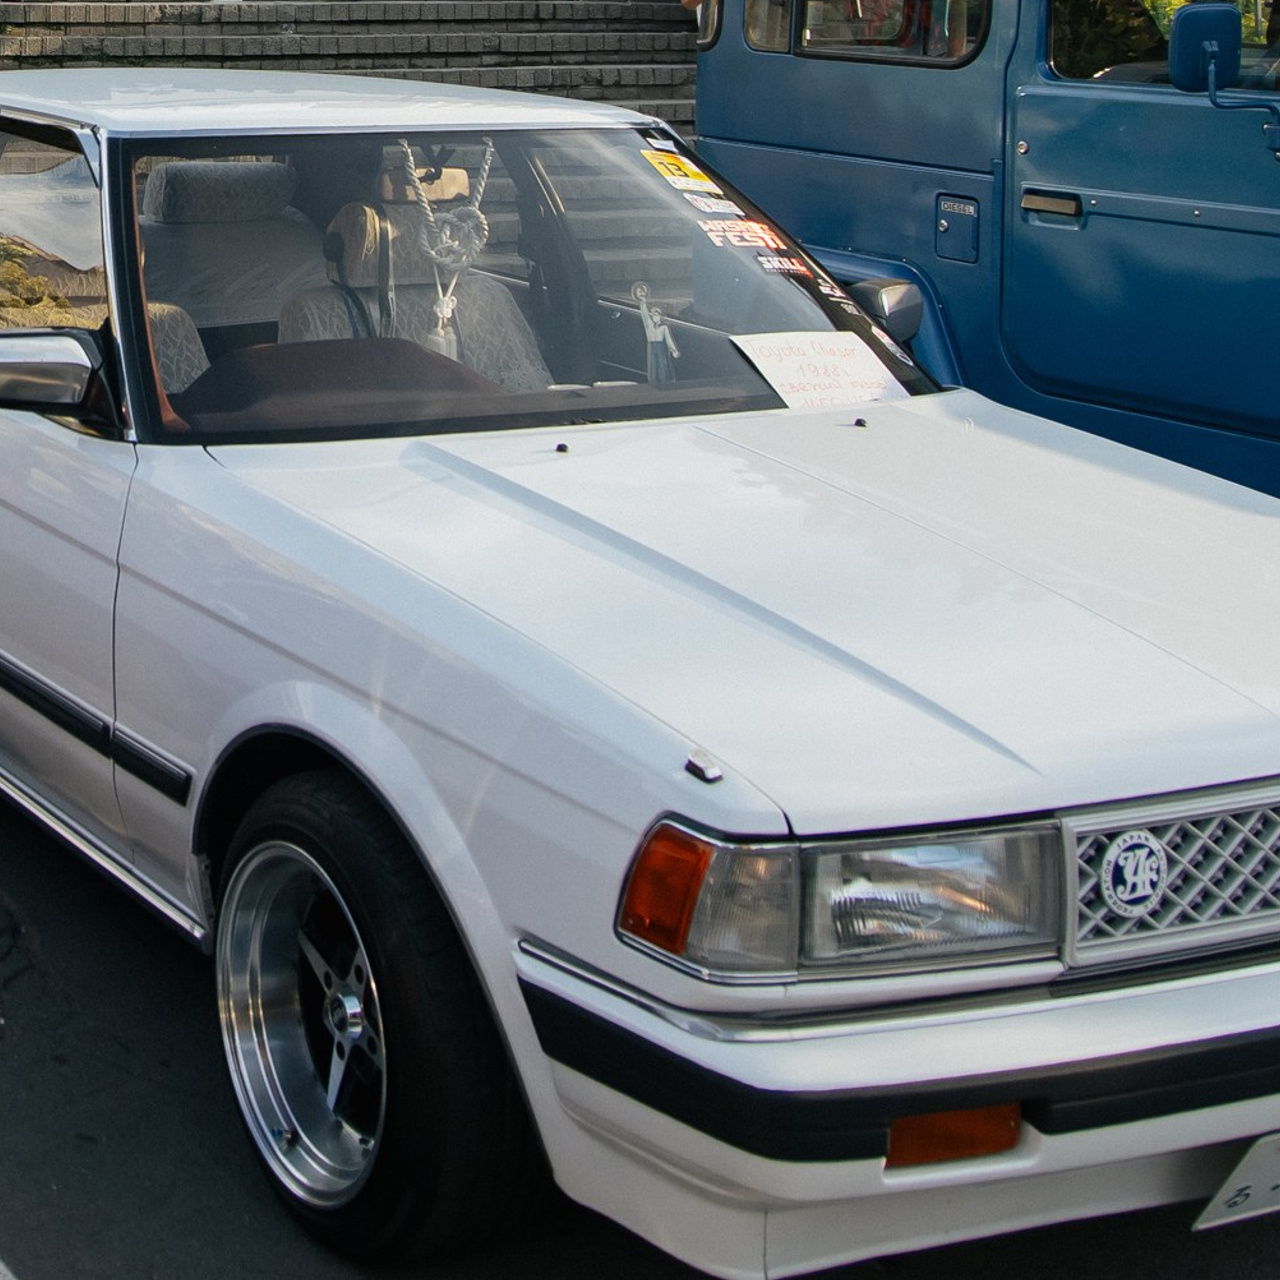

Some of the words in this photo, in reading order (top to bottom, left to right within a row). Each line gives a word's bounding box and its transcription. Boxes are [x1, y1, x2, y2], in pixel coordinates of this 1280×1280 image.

[658, 161, 690, 178] 13
[942, 202, 974, 213] DIESEL
[1117, 834, 1150, 850] JAPAN
